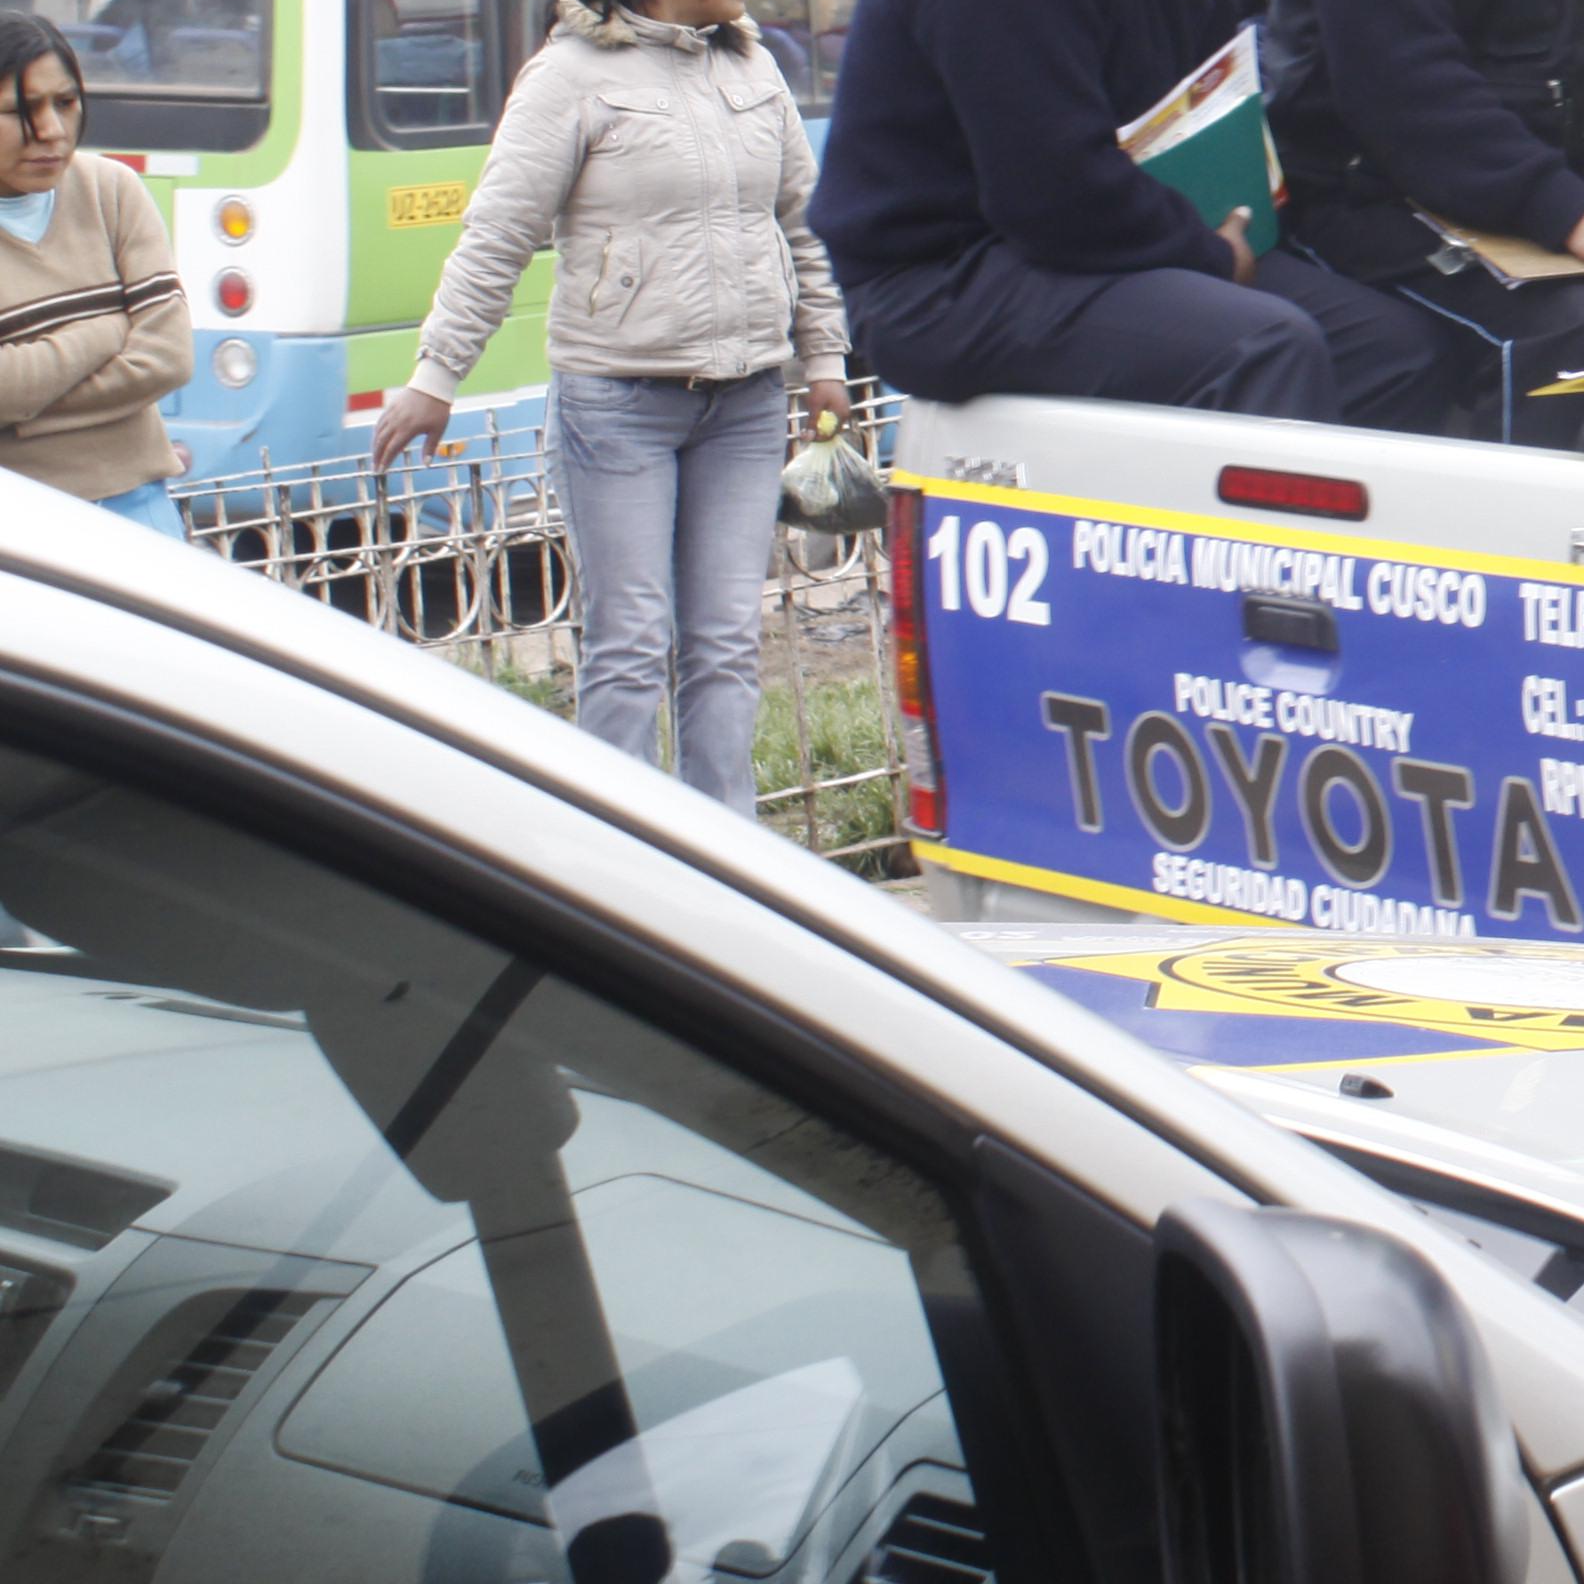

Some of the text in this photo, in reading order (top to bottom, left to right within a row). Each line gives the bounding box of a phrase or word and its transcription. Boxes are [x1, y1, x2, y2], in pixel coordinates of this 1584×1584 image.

[928, 515, 1051, 626] 102
[1073, 520, 1487, 628] POLICIA MUNICIPAL CUSCO
[1173, 672, 1415, 753] POLICE COUNTRY
[1040, 689, 1584, 934] TOYOTA
[1152, 852, 1477, 937] SEGURIDAD CIUDADANA
